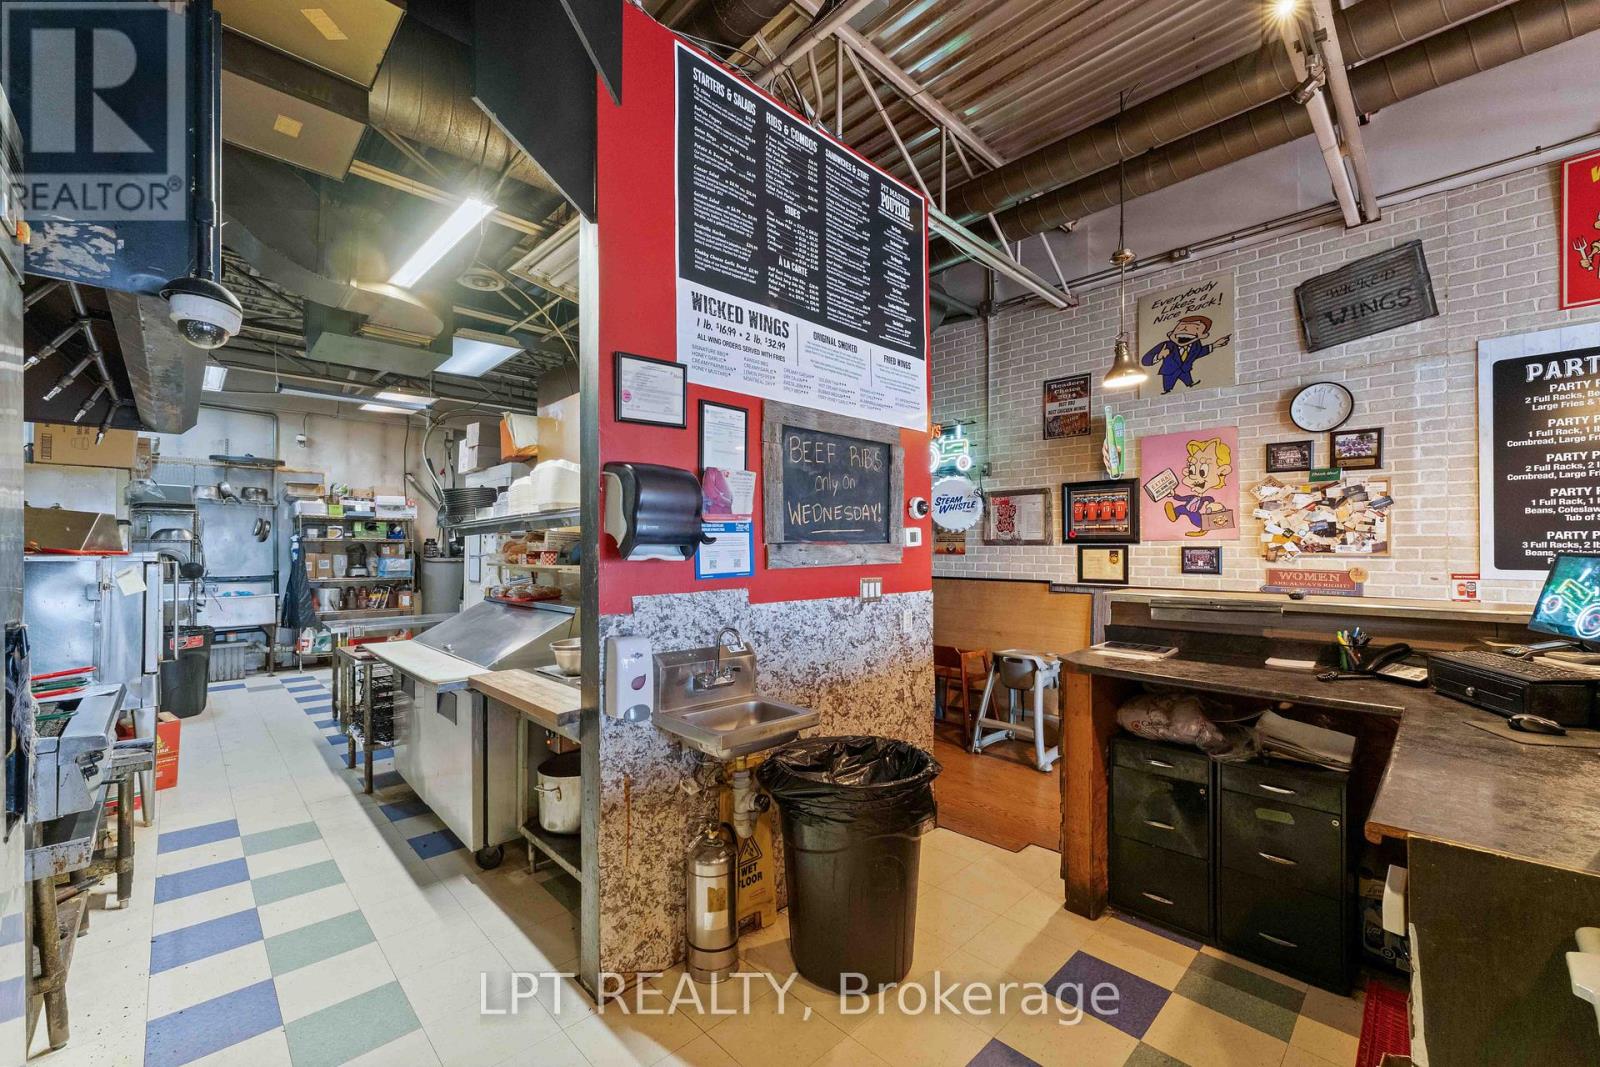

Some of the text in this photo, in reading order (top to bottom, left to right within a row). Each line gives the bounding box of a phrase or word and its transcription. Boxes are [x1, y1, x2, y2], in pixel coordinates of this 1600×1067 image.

[693, 66, 724, 98] STARTERS
[727, 88, 732, 102] &
[733, 92, 755, 116] SALADS
[766, 111, 782, 132] RIBS
[784, 124, 788, 135] &
[790, 127, 817, 153] COMBOS
[852, 164, 856, 174] &
[857, 168, 869, 182] STUFF
[880, 182, 888, 194] PIT
[889, 187, 909, 206] MASTER
[784, 204, 800, 220] SIDES
[880, 191, 910, 222] POUTINE
[783, 259, 790, 269] LA
[792, 262, 807, 277] CARTE
[1152, 281, 1218, 309] Everybody
[1153, 292, 1223, 324] Nice Rack!
[1161, 293, 1208, 314] Likes a
[1324, 287, 1412, 325] WINGS
[691, 290, 789, 339] WICKED WINGS
[703, 318, 712, 330] lb.
[715, 322, 736, 337] $16.99
[745, 332, 750, 341] 2
[753, 334, 761, 344] lb.
[765, 337, 785, 351] $32.99
[813, 331, 857, 353] ORIGINAL SMOKED
[697, 332, 785, 362] ALL WING ORDERS SERVED WITH FRIES
[691, 350, 723, 363] HONEY GARLIC
[883, 353, 911, 370] FRIED WINGS
[691, 363, 707, 372] HONEY
[1051, 380, 1084, 389] Readers
[1550, 380, 1591, 392] PARTY
[1532, 402, 1558, 410] Large
[1561, 400, 1584, 408] Fries
[1533, 395, 1551, 403] Full
[1553, 393, 1585, 401] Racks,
[1547, 416, 1590, 428] PARTY
[1536, 429, 1553, 437] Full
[1556, 427, 1582, 435] Rack,
[1507, 437, 1557, 447] Cornbread,
[1559, 434, 1586, 443] Large
[789, 436, 882, 471] BEEF RIBS
[1546, 452, 1588, 462] PARTY
[1507, 472, 1557, 480] Cornbread,
[1550, 487, 1592, 496] PARTY
[935, 496, 963, 506] STEAM
[939, 501, 976, 514] WHISTLE
[788, 500, 882, 525] WEDNESDAY!
[1546, 531, 1589, 540] PARTY
[1277, 572, 1340, 582] WOMEN
[741, 862, 757, 877] WET
